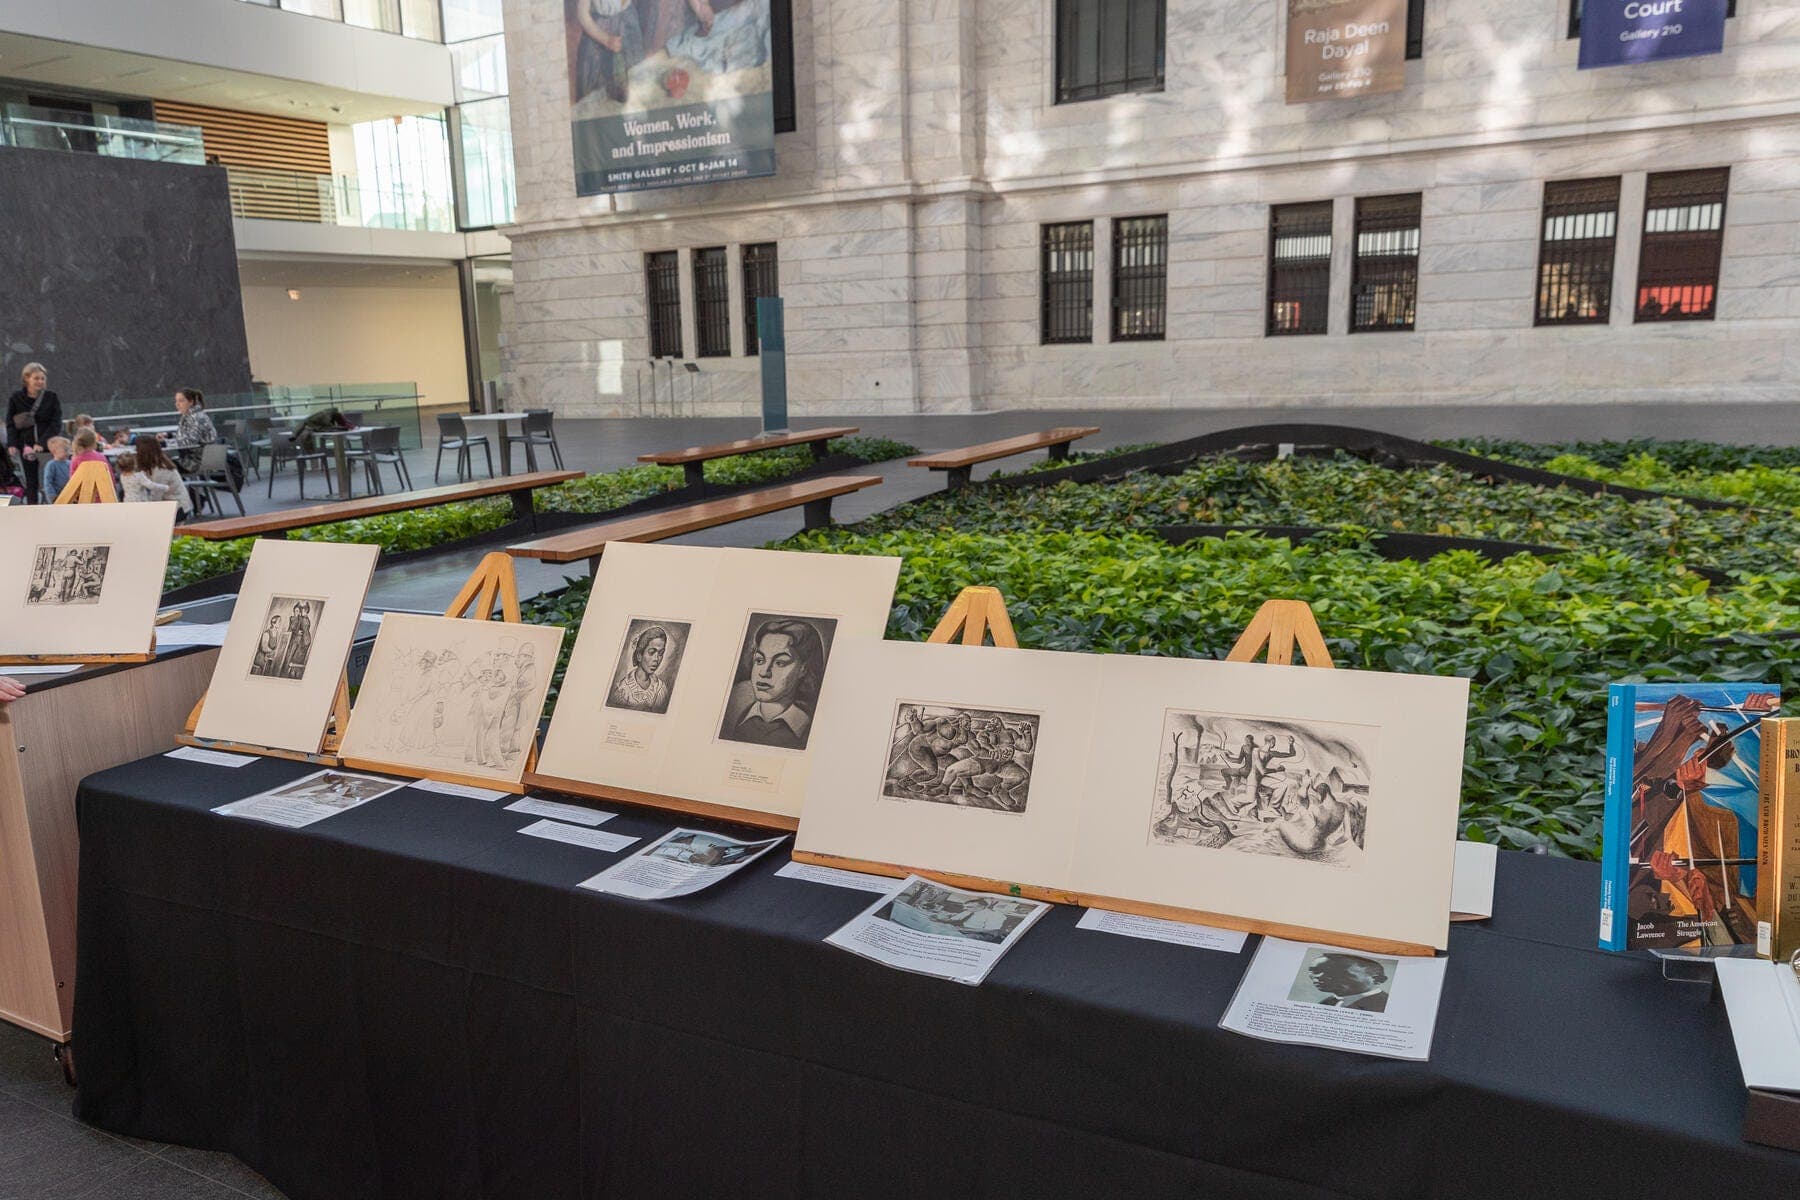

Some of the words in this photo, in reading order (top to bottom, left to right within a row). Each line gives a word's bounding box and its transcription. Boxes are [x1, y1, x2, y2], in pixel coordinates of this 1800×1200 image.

[1624, 0, 1683, 19] Court
[1304, 28, 1340, 45] Raja
[1345, 22, 1389, 39] Deen
[1620, 29, 1659, 41] Gallery
[1322, 39, 1369, 60] Dayal
[624, 121, 674, 136] Women,
[611, 142, 635, 159] and
[637, 132, 731, 155] Impressionism
[607, 171, 633, 183] SMITH
[634, 166, 672, 179] GALLERY
[679, 162, 697, 174] OCT
[1636, 931, 1665, 939] Lawrence
[1676, 929, 1702, 938] Struggle
[1637, 922, 1655, 931] Jacob
[1690, 920, 1718, 928] American
